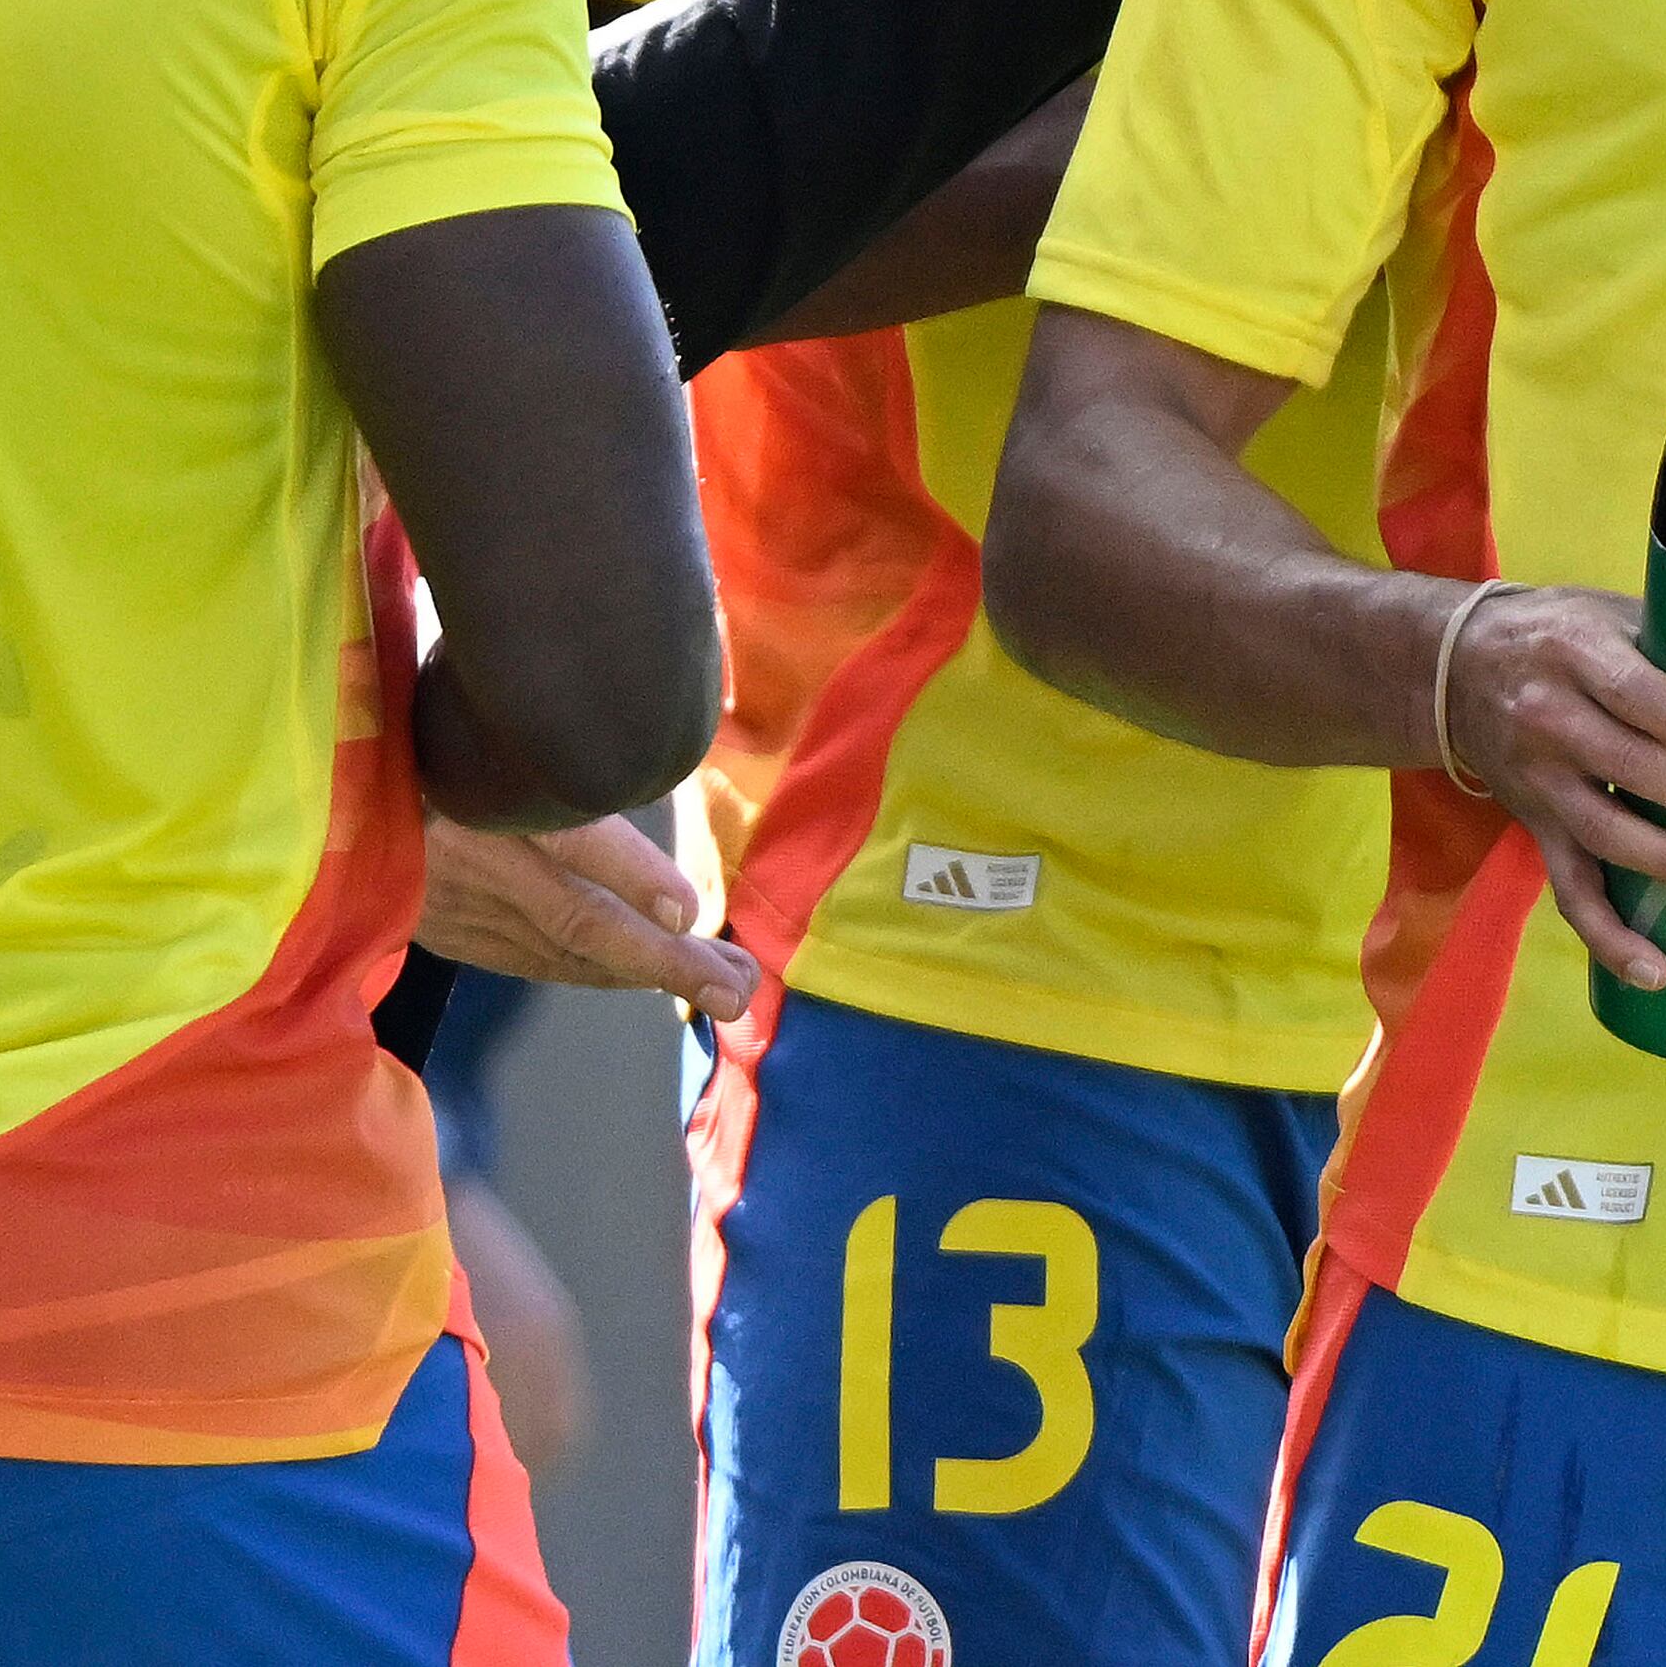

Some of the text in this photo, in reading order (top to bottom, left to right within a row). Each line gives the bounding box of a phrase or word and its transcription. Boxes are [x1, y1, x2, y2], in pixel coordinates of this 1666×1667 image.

[838, 1194, 1099, 1514] 13
[820, 1567, 899, 1591] COLOMBIANA
[900, 1581, 917, 1599] DE
